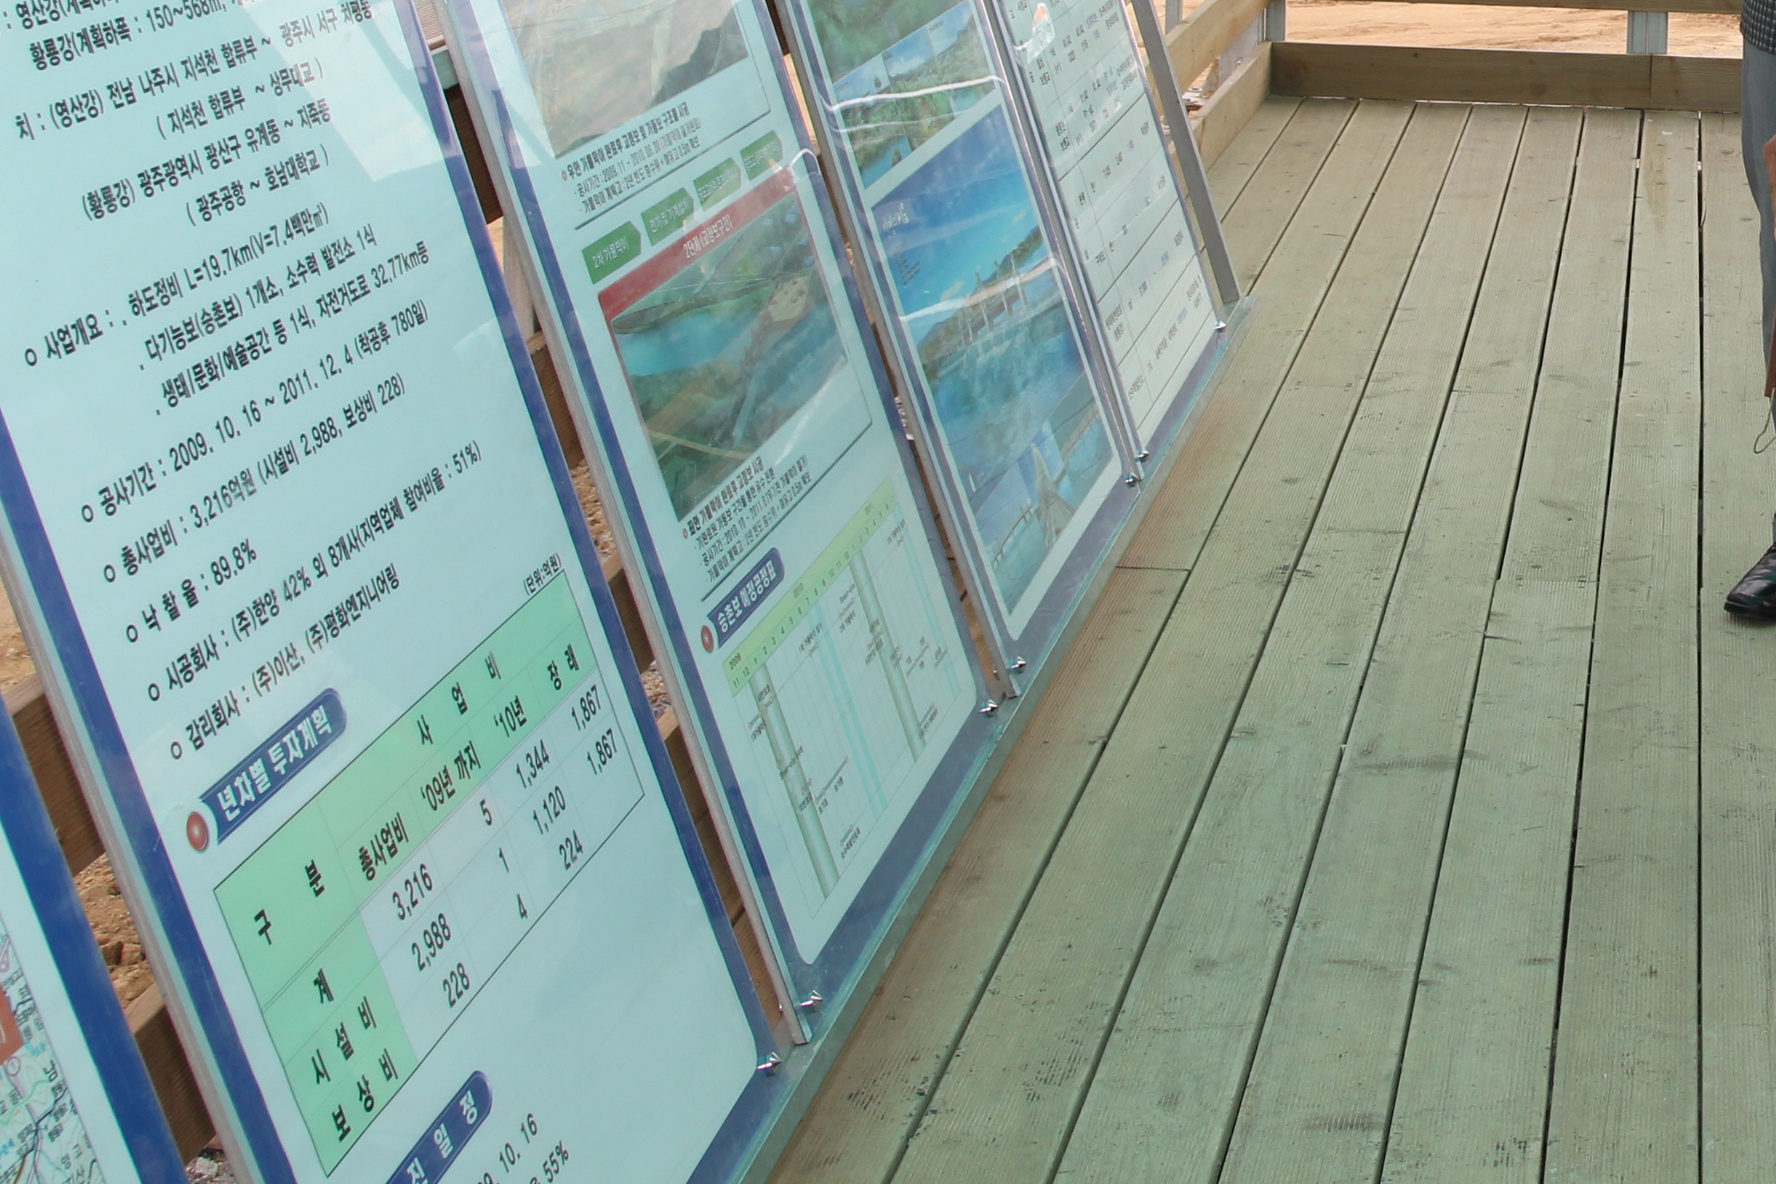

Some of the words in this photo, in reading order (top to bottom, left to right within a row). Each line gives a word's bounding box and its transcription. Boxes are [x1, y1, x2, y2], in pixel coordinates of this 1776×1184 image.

[15, 112, 35, 141] 치
[49, 89, 104, 130] (영산강)
[106, 77, 137, 110] 전남
[138, 62, 180, 97] 나주시
[180, 47, 221, 81] 지석천
[220, 35, 258, 69] 합류부
[278, 14, 316, 48] 광주시
[316, 7, 338, 34] 서구
[29, 16, 132, 71] 황룡강(계획하폭
[166, 99, 209, 134] 지석천
[207, 85, 246, 121] 합류부
[269, 62, 315, 97] 상무대교
[81, 178, 136, 221] (황룡강)
[136, 149, 204, 198] 광주광역시
[203, 134, 242, 170] 광산구
[195, 179, 247, 223] 광주공항
[264, 149, 321, 192] 호남대학교
[44, 313, 104, 360] 사업개요
[128, 272, 184, 317] 하도정비
[144, 293, 243, 361] 다기능보(승촌보)
[245, 275, 284, 309] 1개소,
[286, 251, 321, 289] 소수력
[320, 236, 356, 271] 발전소
[356, 223, 378, 251] 1식
[161, 326, 273, 409] 생태/문화/예술공간
[272, 318, 288, 346] 등
[289, 304, 317, 335] 1식,
[315, 273, 372, 318] 자전거도로
[370, 240, 430, 289] 32.77km등
[97, 461, 157, 517] 공사기간
[168, 431, 214, 473] 2009.
[214, 415, 241, 444] 10.
[242, 399, 262, 427] 16
[278, 368, 319, 405] 2011.
[319, 353, 343, 380] 12.
[343, 344, 354, 365] 4
[354, 320, 392, 360] (착공후
[390, 299, 429, 336] 780일)
[121, 519, 178, 577] 총사업비
[189, 467, 257, 529] 3,216억원
[256, 439, 300, 485] (시설비
[299, 416, 343, 457] 2,988,
[342, 389, 378, 429] 보상비
[377, 372, 406, 406] 228)
[141, 603, 162, 631] 낙
[161, 590, 181, 622] 찰
[181, 578, 200, 609] 율
[210, 538, 257, 586] 89.8%
[165, 633, 220, 690] 시공회사
[231, 588, 280, 643] (주)한양
[282, 566, 312, 602] 42%
[312, 552, 329, 580] 외
[327, 496, 405, 568] 8개사(지역업체
[402, 467, 446, 513] 참여비율
[452, 440, 482, 475] 51%)
[717, 595, 743, 633] 승촌보
[739, 559, 777, 608] 예정공정표
[185, 689, 241, 751] 감리회사
[251, 642, 306, 698] (주)이산,
[305, 562, 400, 654] (주)평화엔지니어링
[416, 714, 434, 746] 사
[450, 681, 468, 716] 업
[484, 652, 502, 680] 비
[217, 757, 271, 822] 년차별
[267, 705, 333, 775] 투자계획
[358, 811, 409, 882] 총사업비
[453, 740, 482, 780] 까지
[546, 660, 562, 691] 장
[564, 643, 580, 672] 래
[312, 968, 335, 1005] 계
[391, 863, 433, 921] 3,216
[479, 798, 493, 827] 5
[516, 739, 550, 789] 1,344
[571, 684, 602, 731] 1,867
[253, 908, 272, 946] 구
[304, 859, 325, 898] 분
[311, 1048, 331, 1085] 시
[334, 1021, 355, 1061] 설
[356, 995, 377, 1030] 비
[411, 912, 452, 972] 2,988
[498, 847, 510, 873] 1
[532, 785, 566, 835] 1,120
[587, 727, 618, 775] 1,867
[331, 1104, 352, 1143] 보
[356, 1074, 375, 1113] 상
[378, 1048, 399, 1082] 비
[442, 962, 471, 1009] 228
[516, 893, 528, 920] 4
[558, 829, 584, 871] 224
[433, 1122, 454, 1159] 일
[459, 1090, 478, 1125] 정
[498, 1142, 521, 1174] 10.
[520, 1112, 538, 1144] 16
[542, 1140, 569, 1184] 55%
